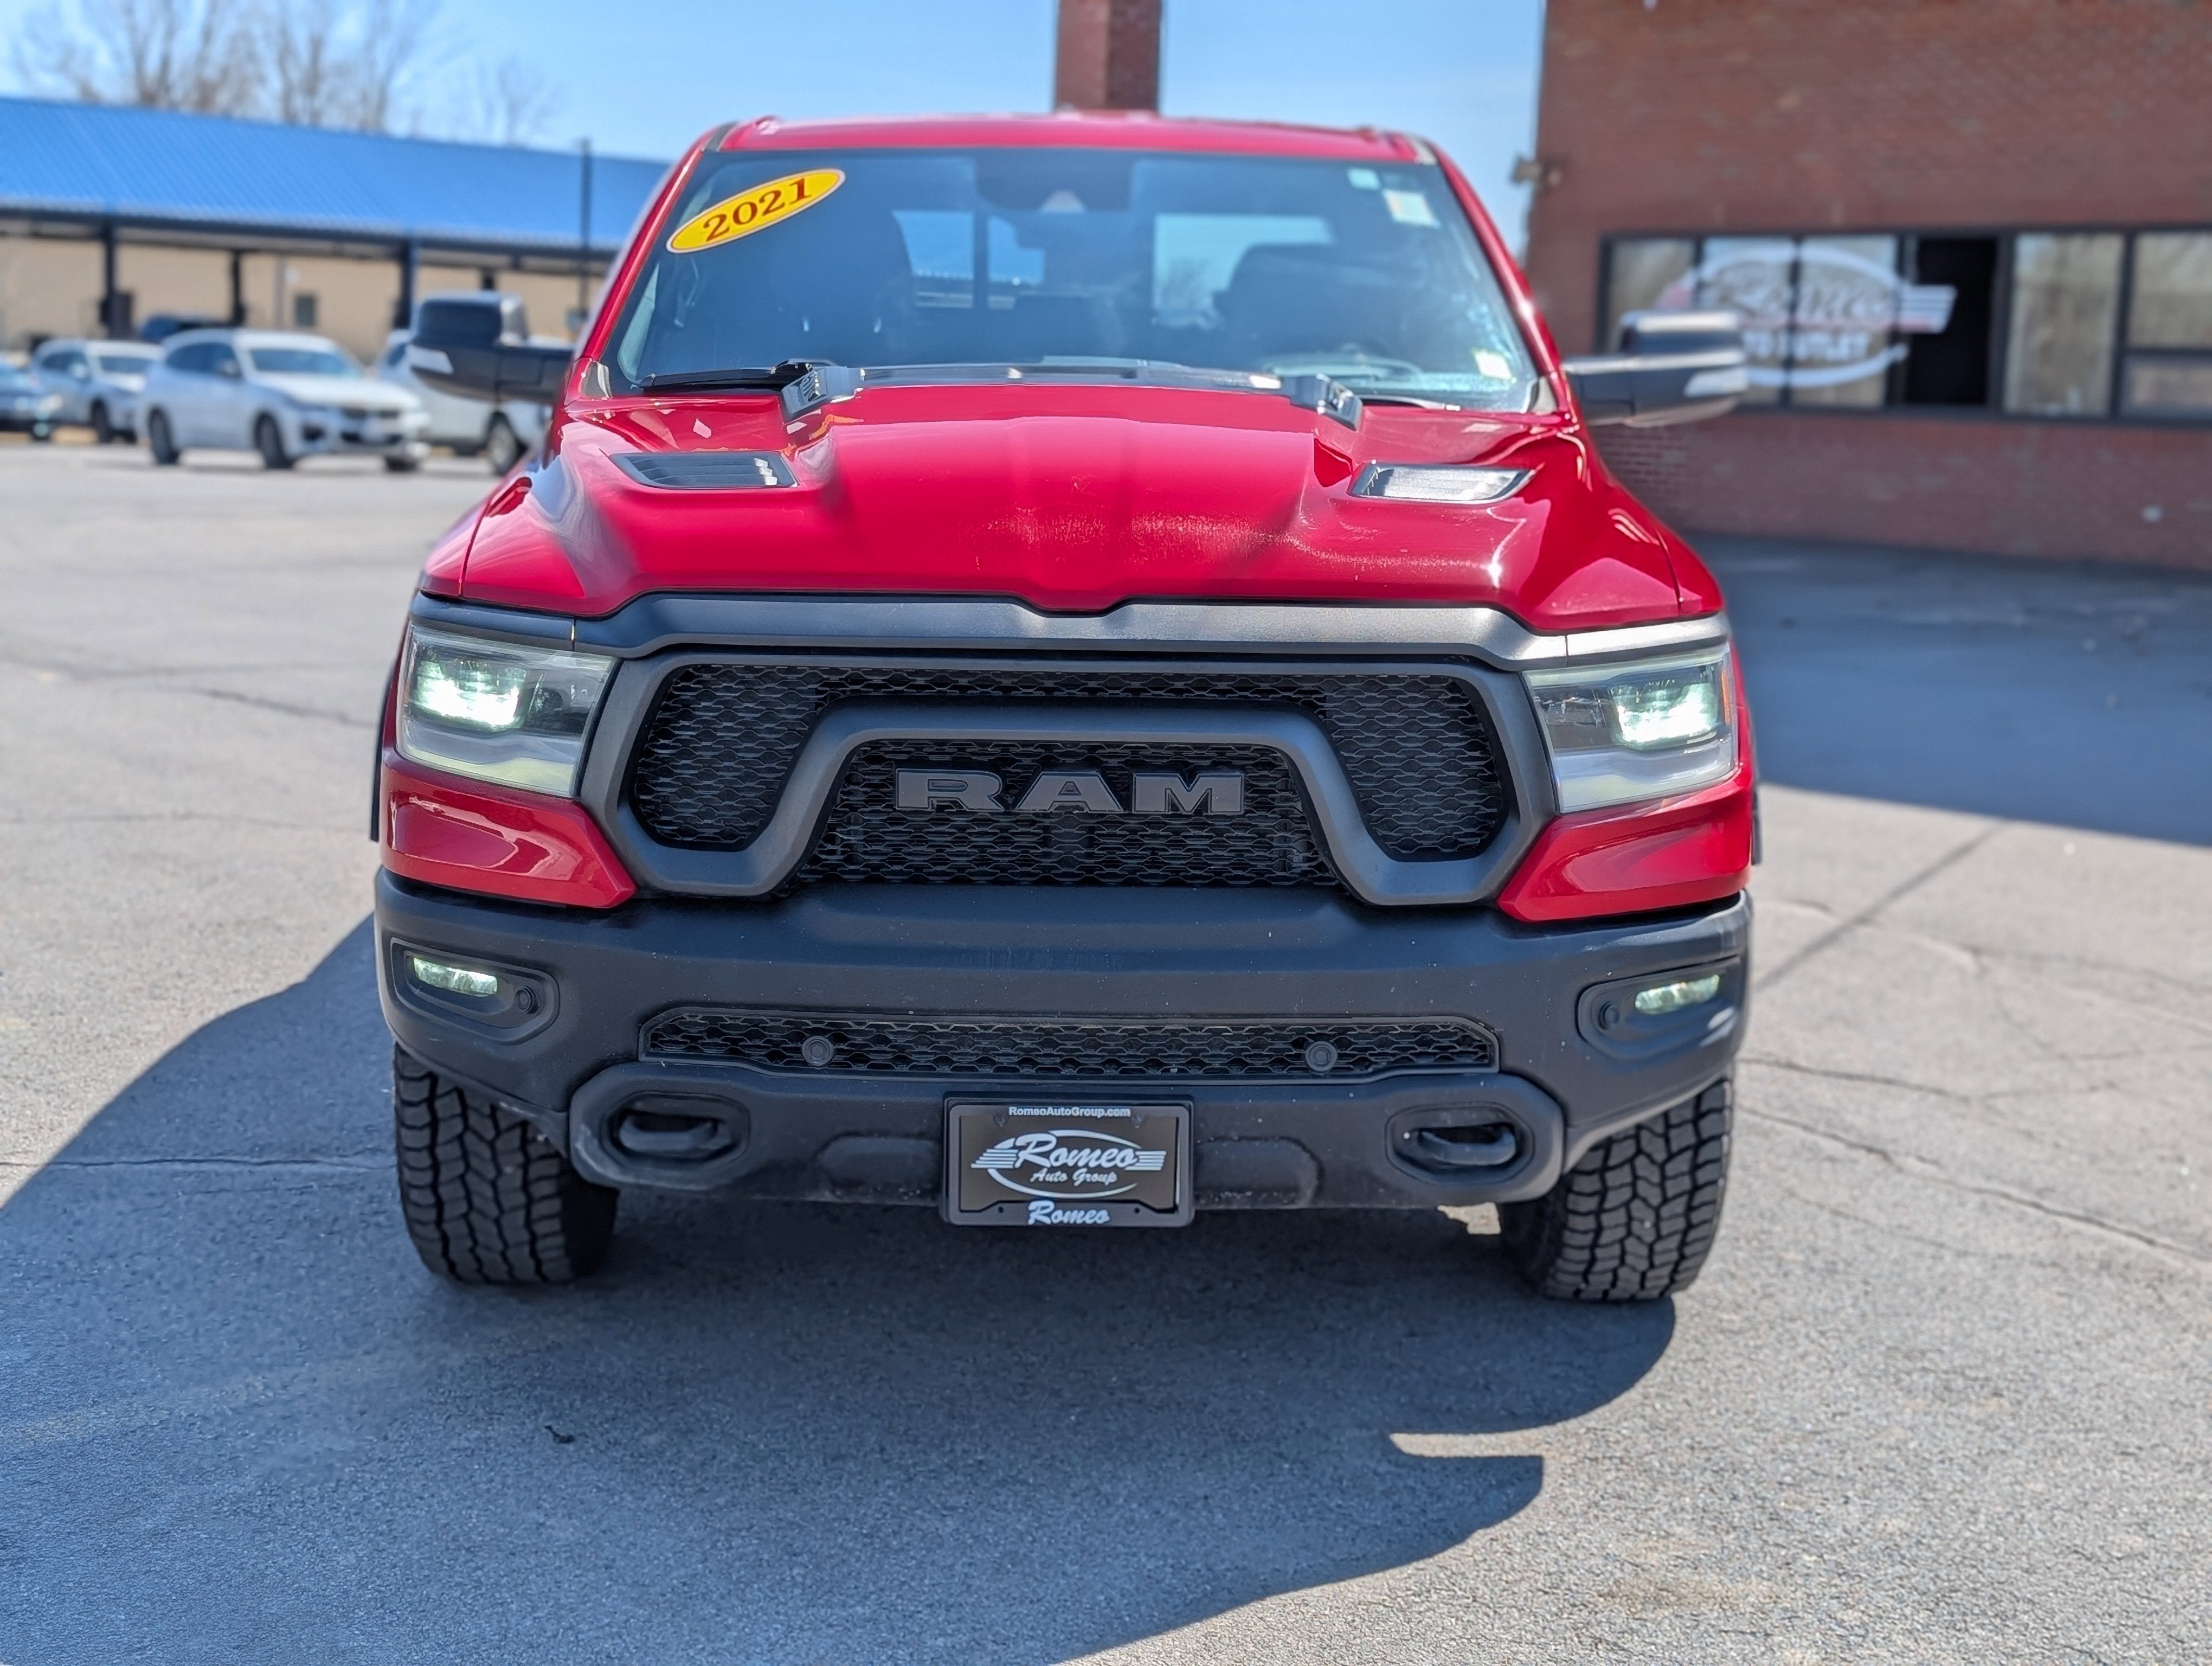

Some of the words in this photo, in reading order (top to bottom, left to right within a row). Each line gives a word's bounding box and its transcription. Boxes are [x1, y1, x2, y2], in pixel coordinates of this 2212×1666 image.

[703, 177, 811, 242] 2021
[895, 768, 1245, 813] RAM
[1008, 1106, 1131, 1118] RomeoAutoGroup.com
[1014, 1132, 1138, 1169] Romeo
[1030, 1168, 1068, 1183] Auto
[1072, 1168, 1118, 1187] Group
[1028, 1200, 1110, 1225] Romeo
